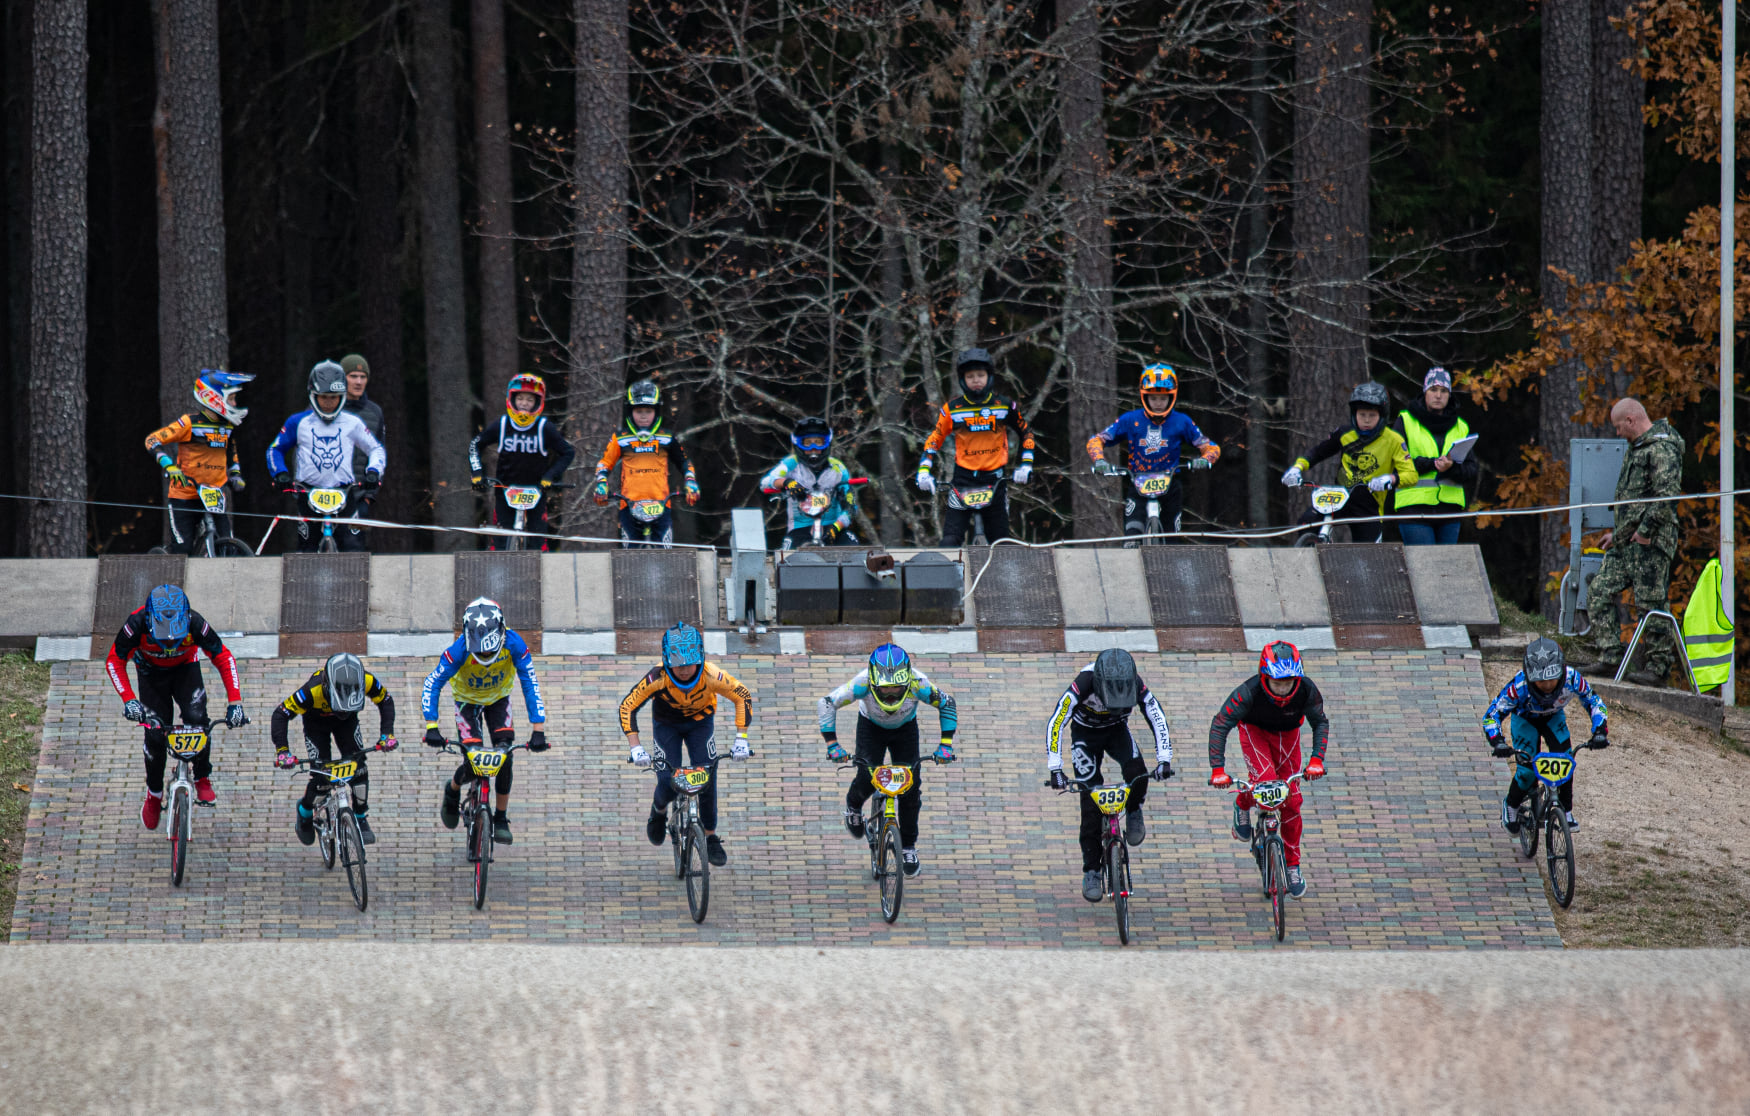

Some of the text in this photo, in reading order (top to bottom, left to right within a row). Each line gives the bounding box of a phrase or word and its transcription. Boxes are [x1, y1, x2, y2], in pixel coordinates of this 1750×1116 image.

[963, 415, 997, 431] RIGA
[504, 434, 538, 453] shit!
[1144, 480, 1166, 491] 493
[317, 494, 336, 505] 491
[517, 494, 535, 504] 198
[968, 493, 989, 504] 327
[1149, 705, 1169, 751] FREIMANS
[174, 735, 202, 751] 577
[473, 752, 501, 768] 400
[1539, 759, 1571, 776] 207
[334, 764, 352, 777] 777
[690, 771, 706, 784] 300
[1098, 790, 1125, 806] 393
[1261, 787, 1282, 802] 830
